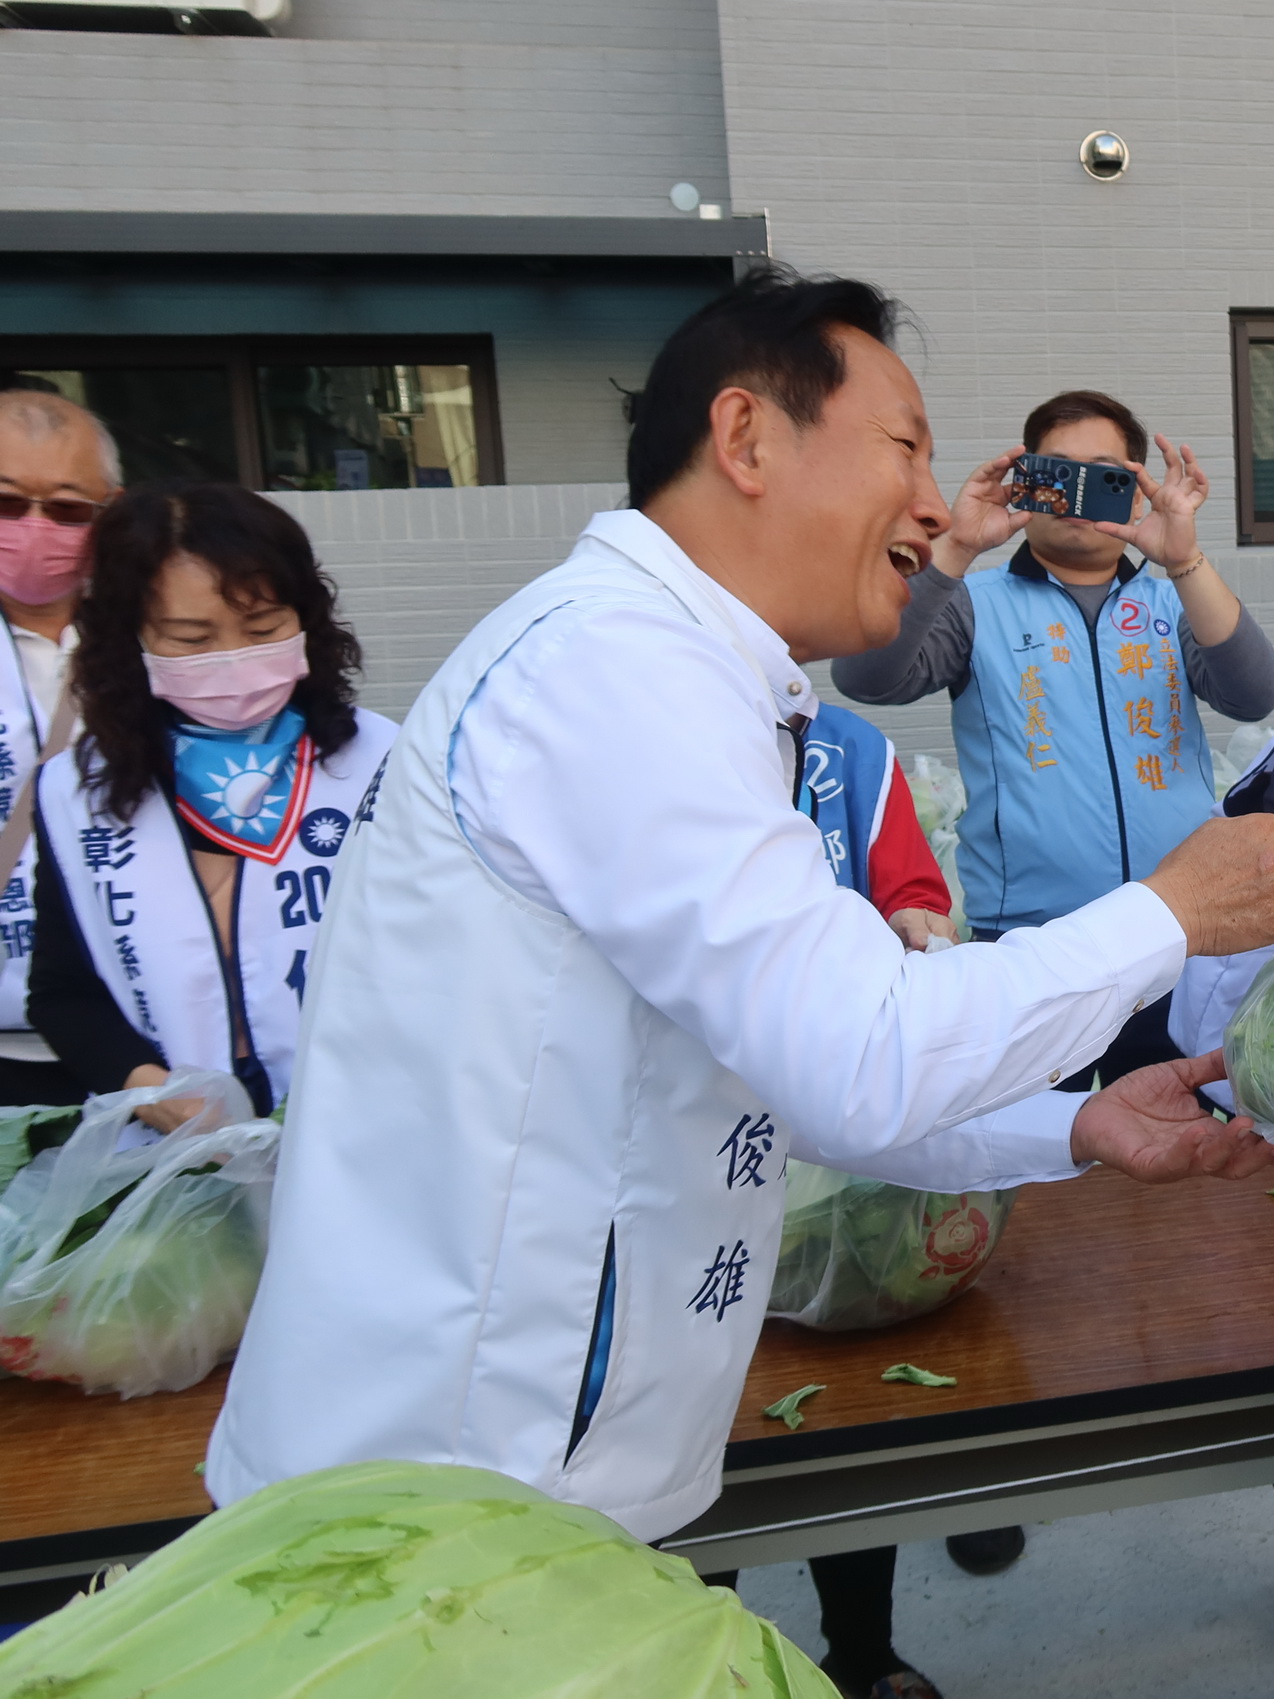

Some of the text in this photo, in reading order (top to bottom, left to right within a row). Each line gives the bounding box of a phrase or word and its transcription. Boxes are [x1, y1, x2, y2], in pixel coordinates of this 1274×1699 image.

[1046, 622, 1071, 664] 特助
[1120, 602, 1142, 631] 2
[1018, 665, 1058, 773] 盧義仁
[1116, 642, 1168, 791] 鄭俊雄
[1159, 637, 1186, 773] 立法委員參選人
[804, 748, 838, 795] 2
[685, 1112, 775, 1323] 俊雄
